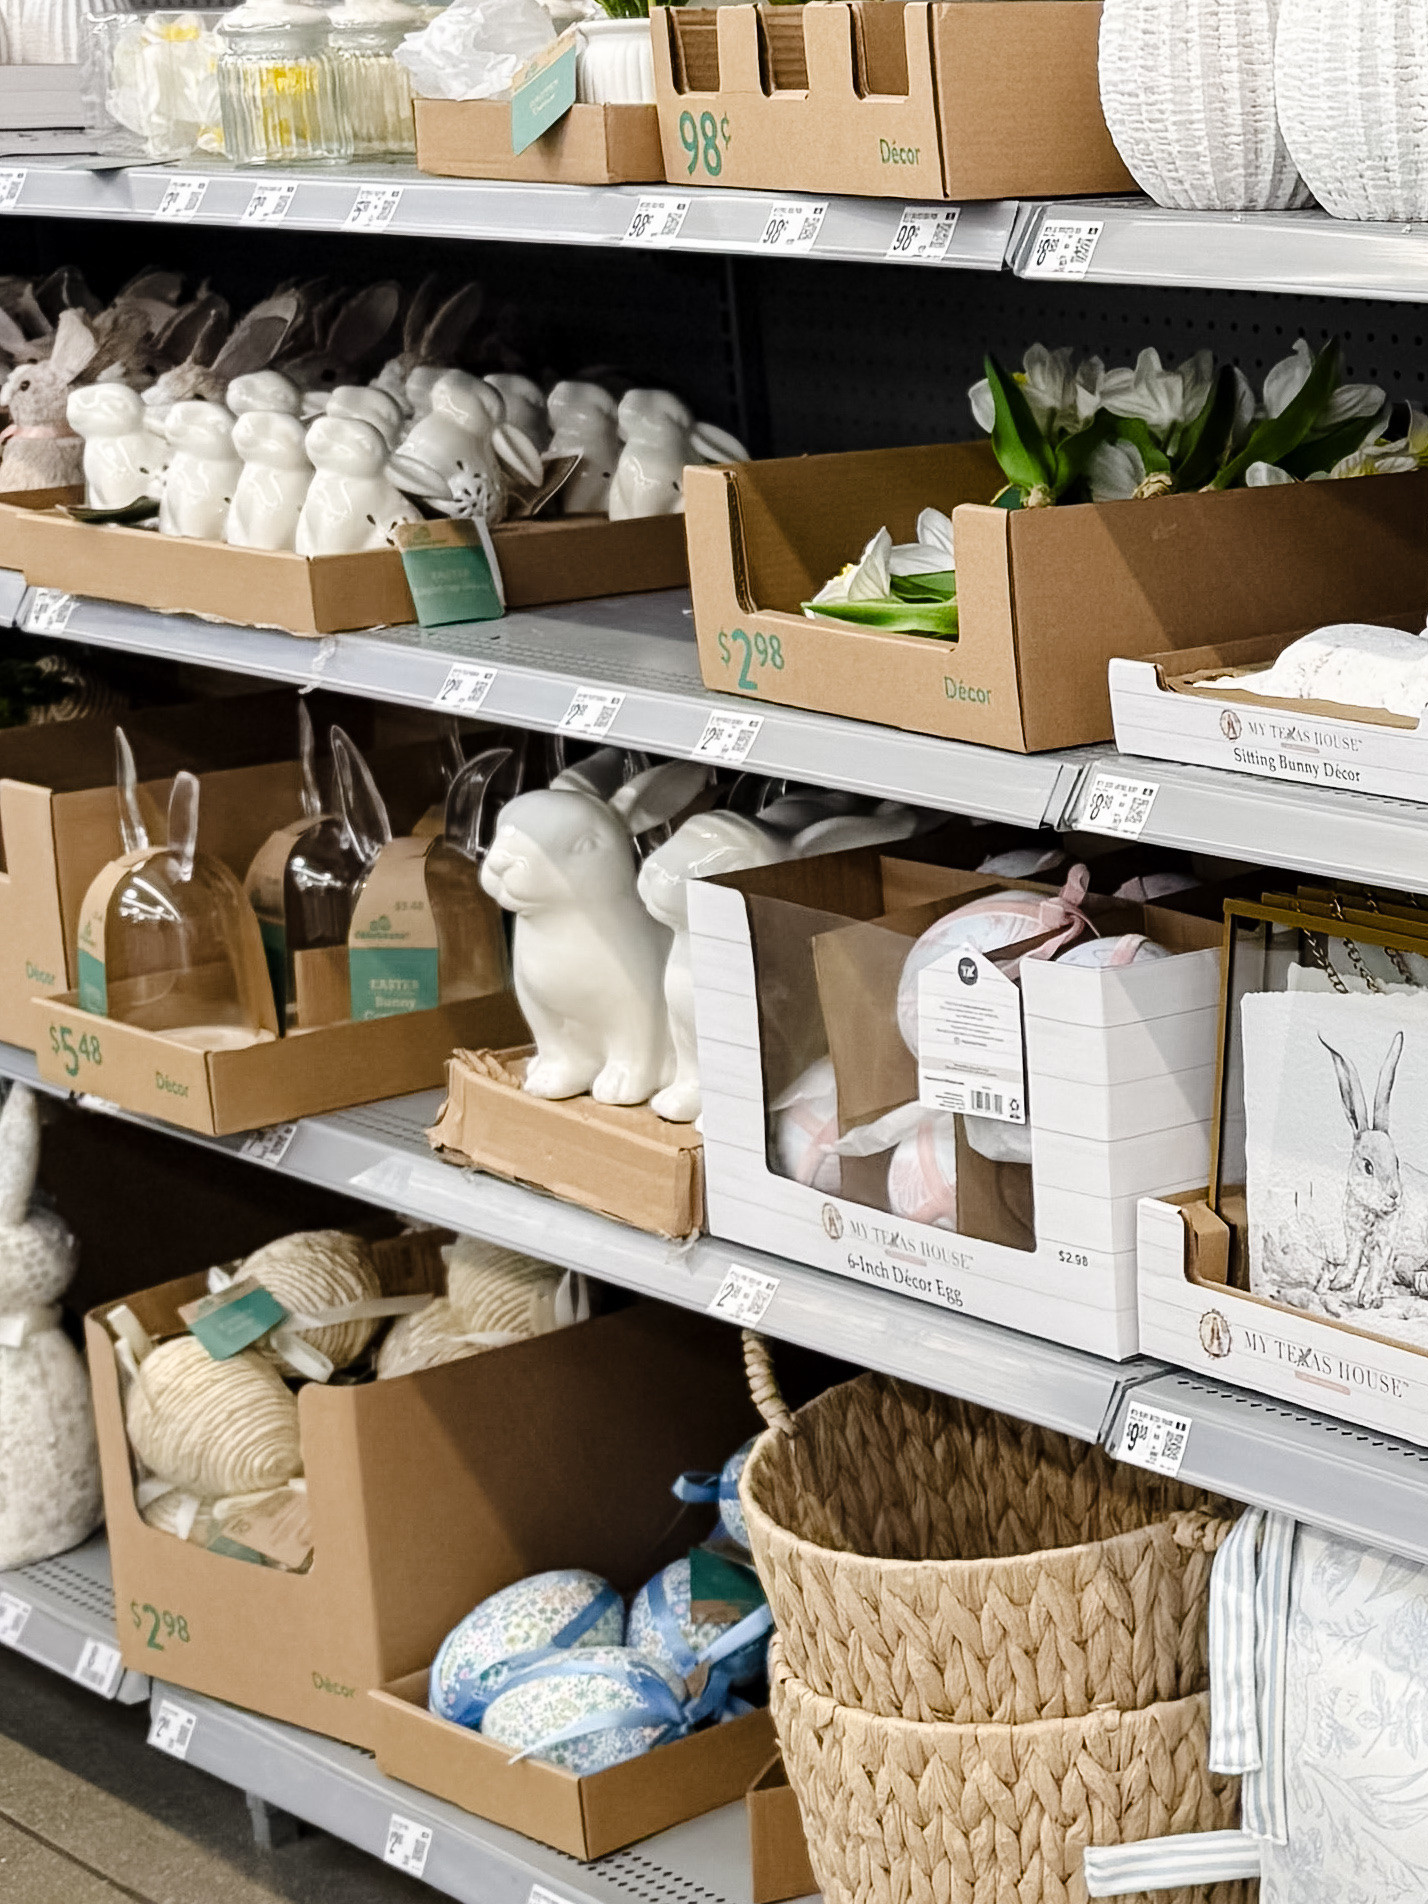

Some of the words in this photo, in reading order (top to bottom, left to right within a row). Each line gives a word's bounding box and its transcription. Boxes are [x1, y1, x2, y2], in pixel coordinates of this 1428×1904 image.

[880, 138, 920, 166] Décor
[944, 676, 992, 707] Décor
[1248, 720, 1268, 737] MY
[1270, 723, 1311, 745] TEXAS
[1233, 747, 1276, 774] Sitting
[1278, 753, 1320, 781] Bunny
[1323, 760, 1361, 784] Décor
[155, 1069, 190, 1099] Décor
[849, 1220, 869, 1238] MY
[871, 1227, 917, 1254] TEXAS
[1058, 1250, 1089, 1267] $2.98
[848, 1253, 890, 1281] 6-Inch
[893, 1264, 933, 1295] Décor
[935, 1277, 964, 1308] Egg
[1244, 1330, 1269, 1354] MY
[1274, 1340, 1333, 1377] TEXAS
